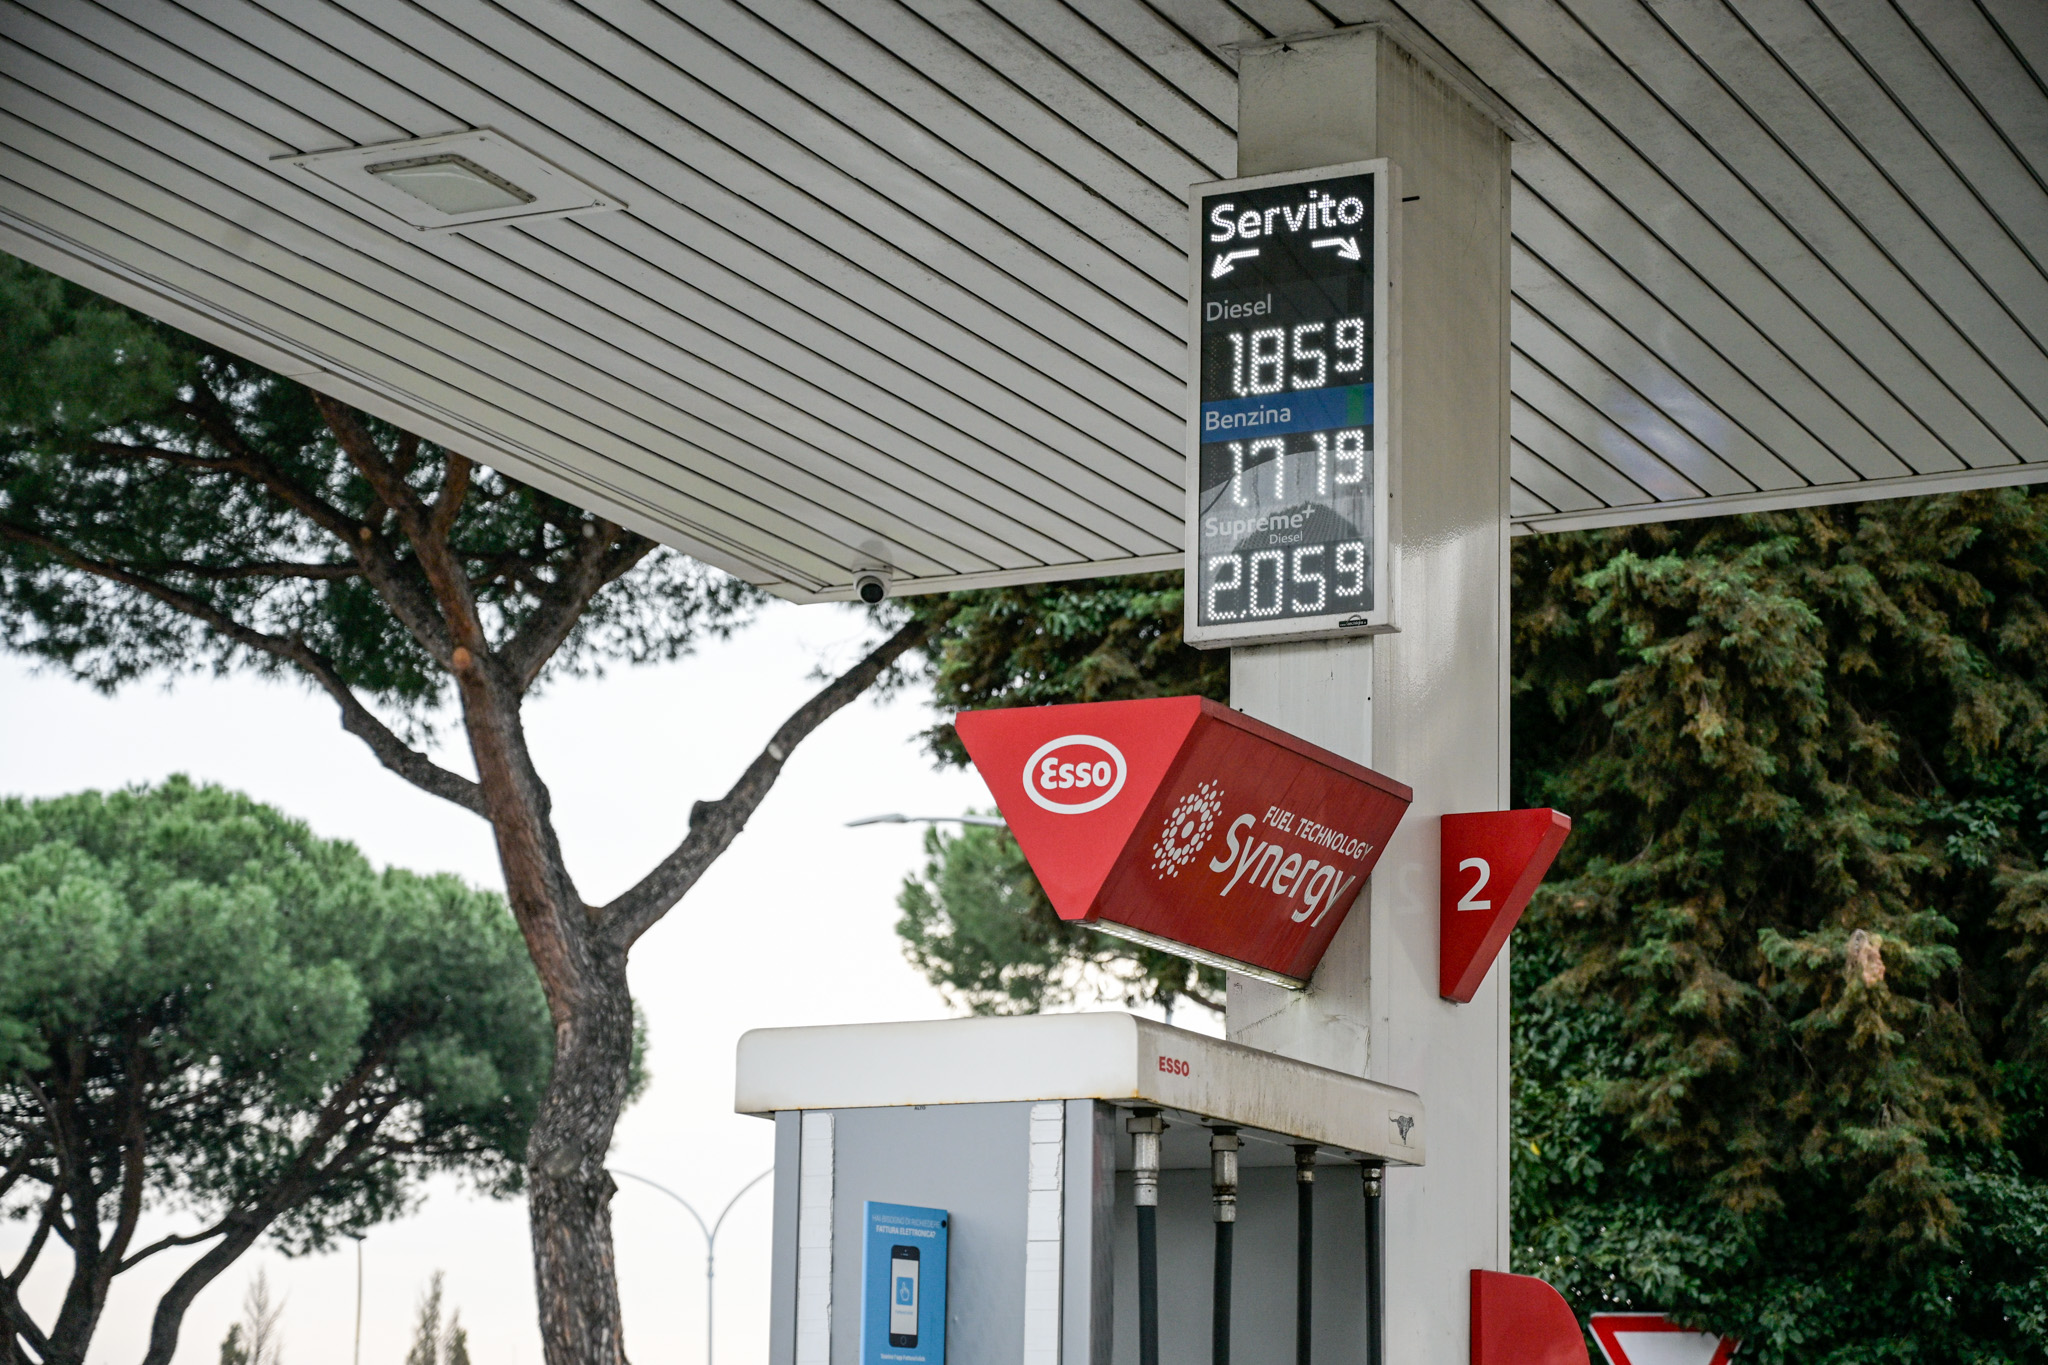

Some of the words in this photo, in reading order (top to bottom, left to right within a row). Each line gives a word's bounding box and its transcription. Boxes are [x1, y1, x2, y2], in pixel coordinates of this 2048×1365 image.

[1210, 189, 1365, 243] Servito
[1206, 293, 1272, 322] Diesel
[1205, 405, 1291, 431] Benzina
[1269, 531, 1303, 545] Diesel
[1262, 805, 1296, 833] FUEL
[1294, 817, 1374, 862] TECHNOLOGY
[1208, 813, 1356, 928] Synergy
[1457, 857, 1491, 911] 2
[1158, 1055, 1190, 1077] ESSO
[875, 1224, 899, 1235] FATTURA
